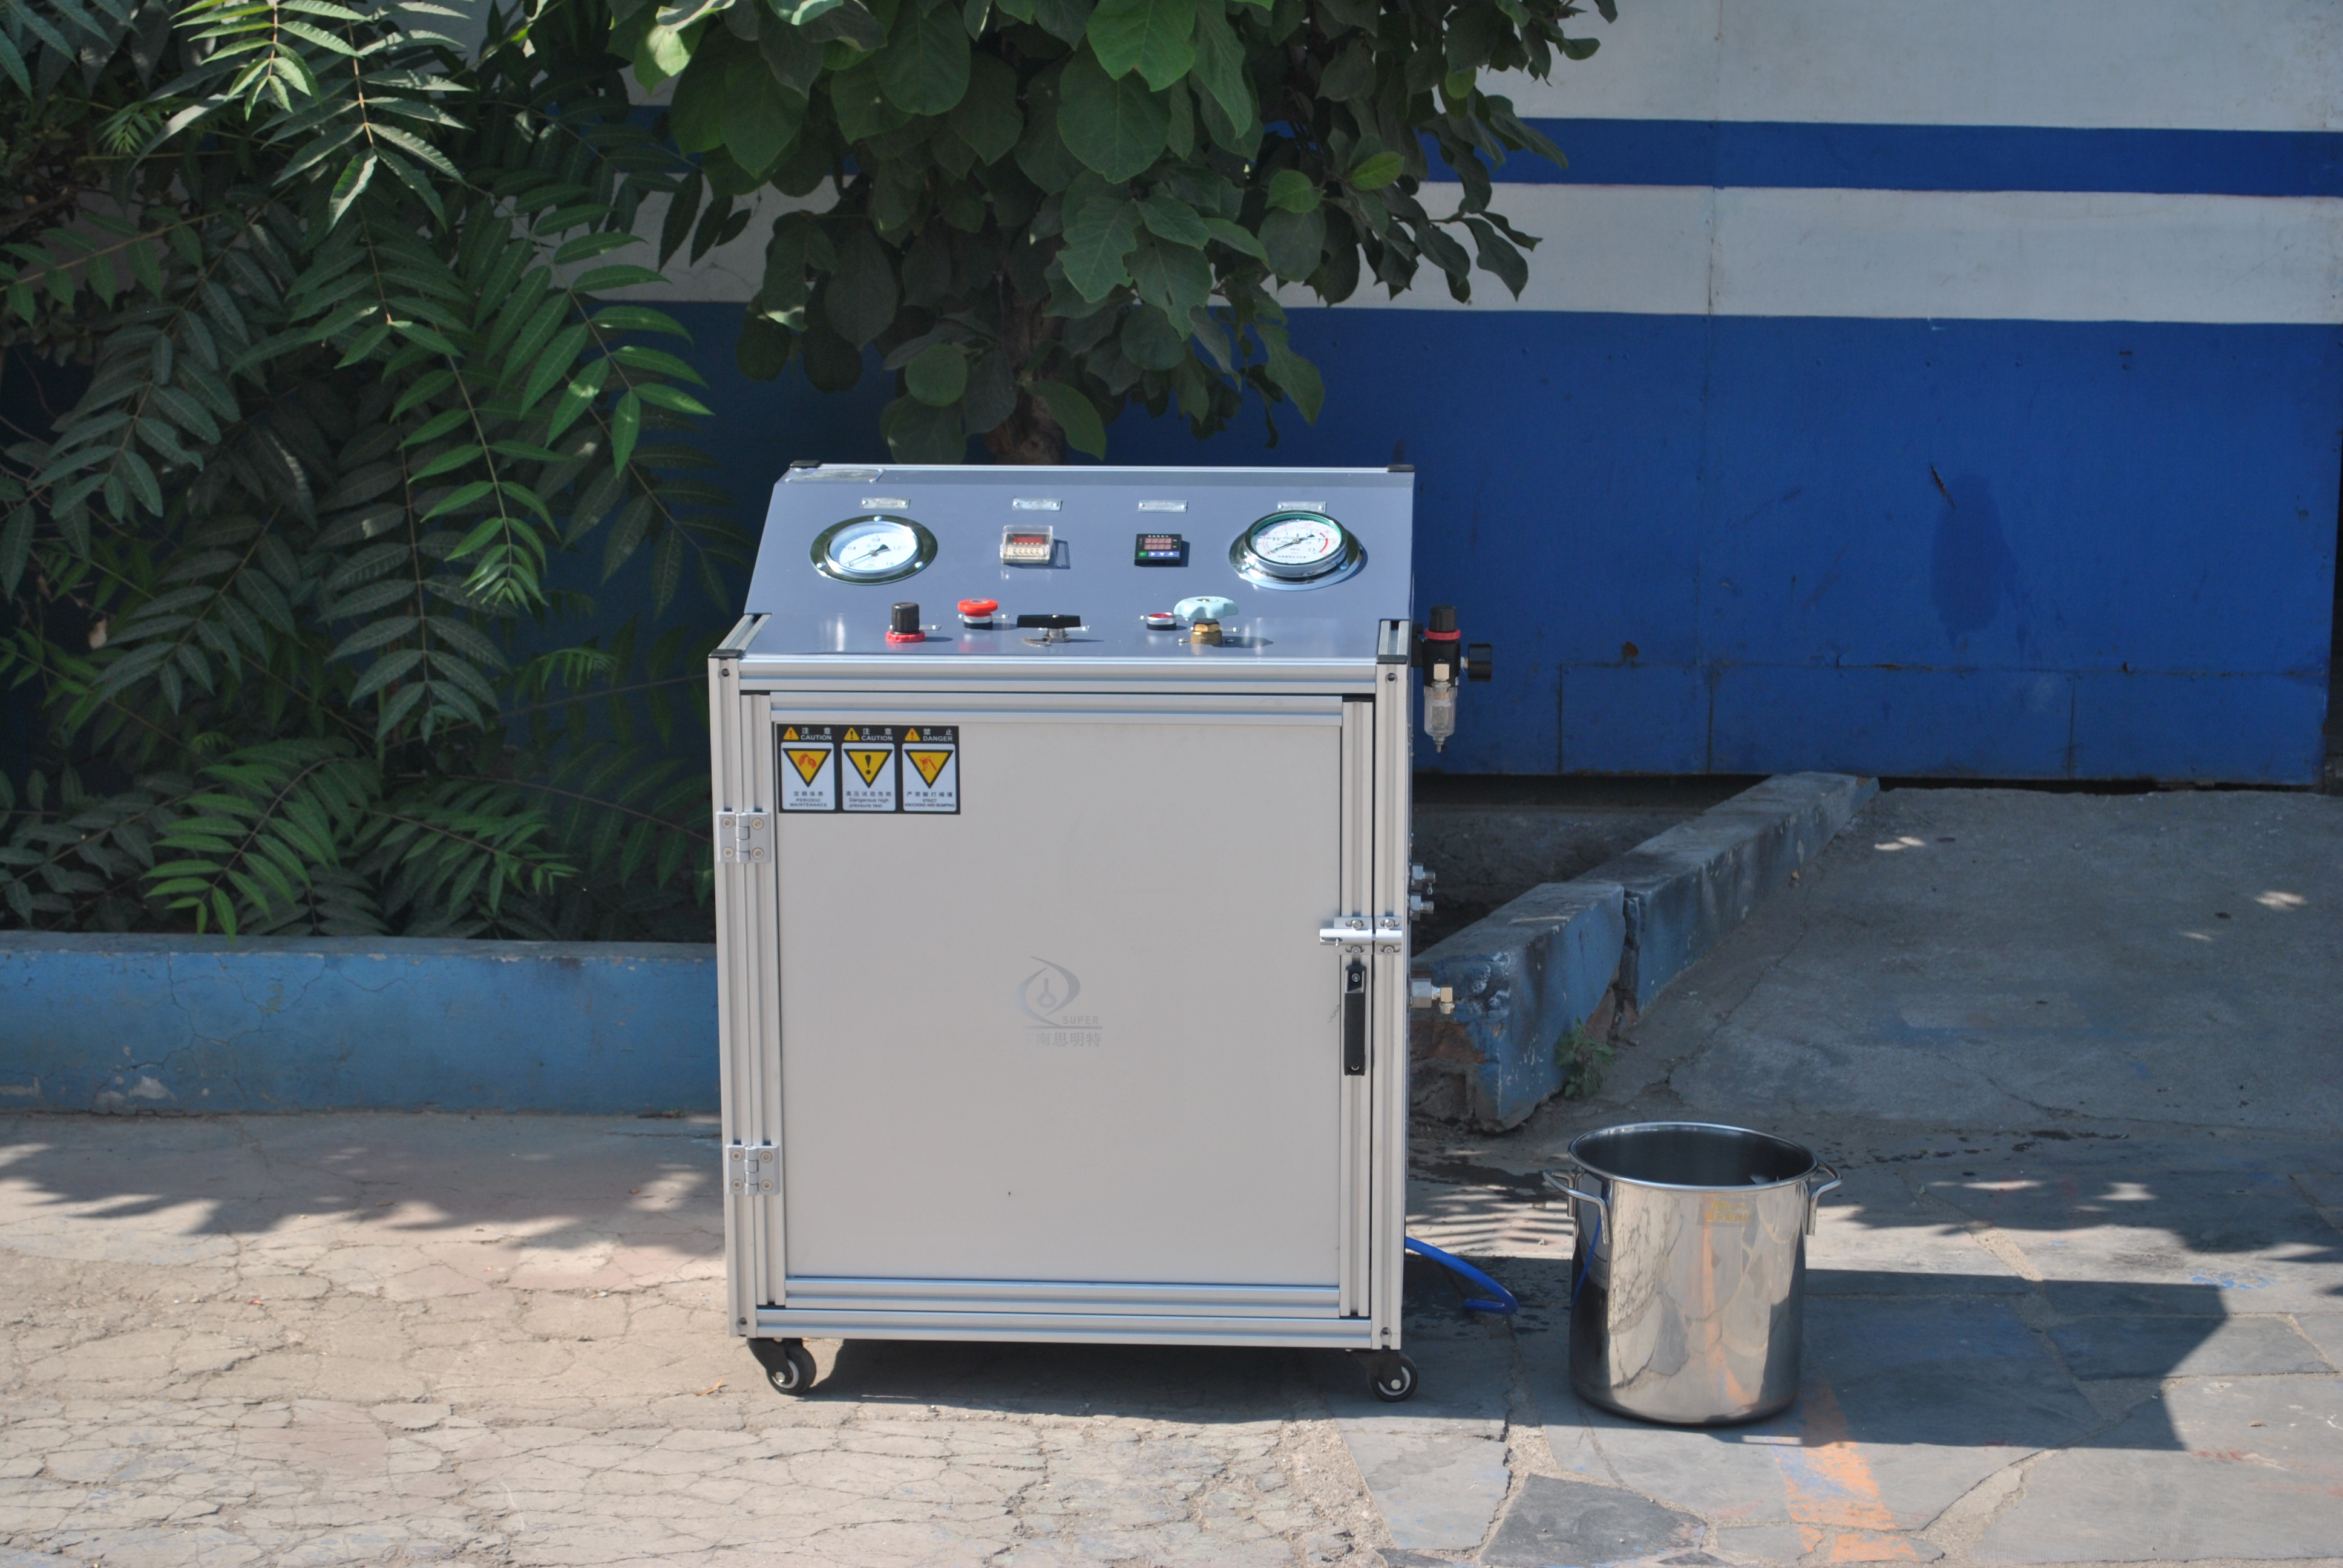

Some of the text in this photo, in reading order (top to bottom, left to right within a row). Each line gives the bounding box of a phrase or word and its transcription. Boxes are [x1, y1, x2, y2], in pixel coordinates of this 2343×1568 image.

[1063, 1016, 1099, 1024] SUPER
[1020, 1031, 1103, 1047] 南思明特
